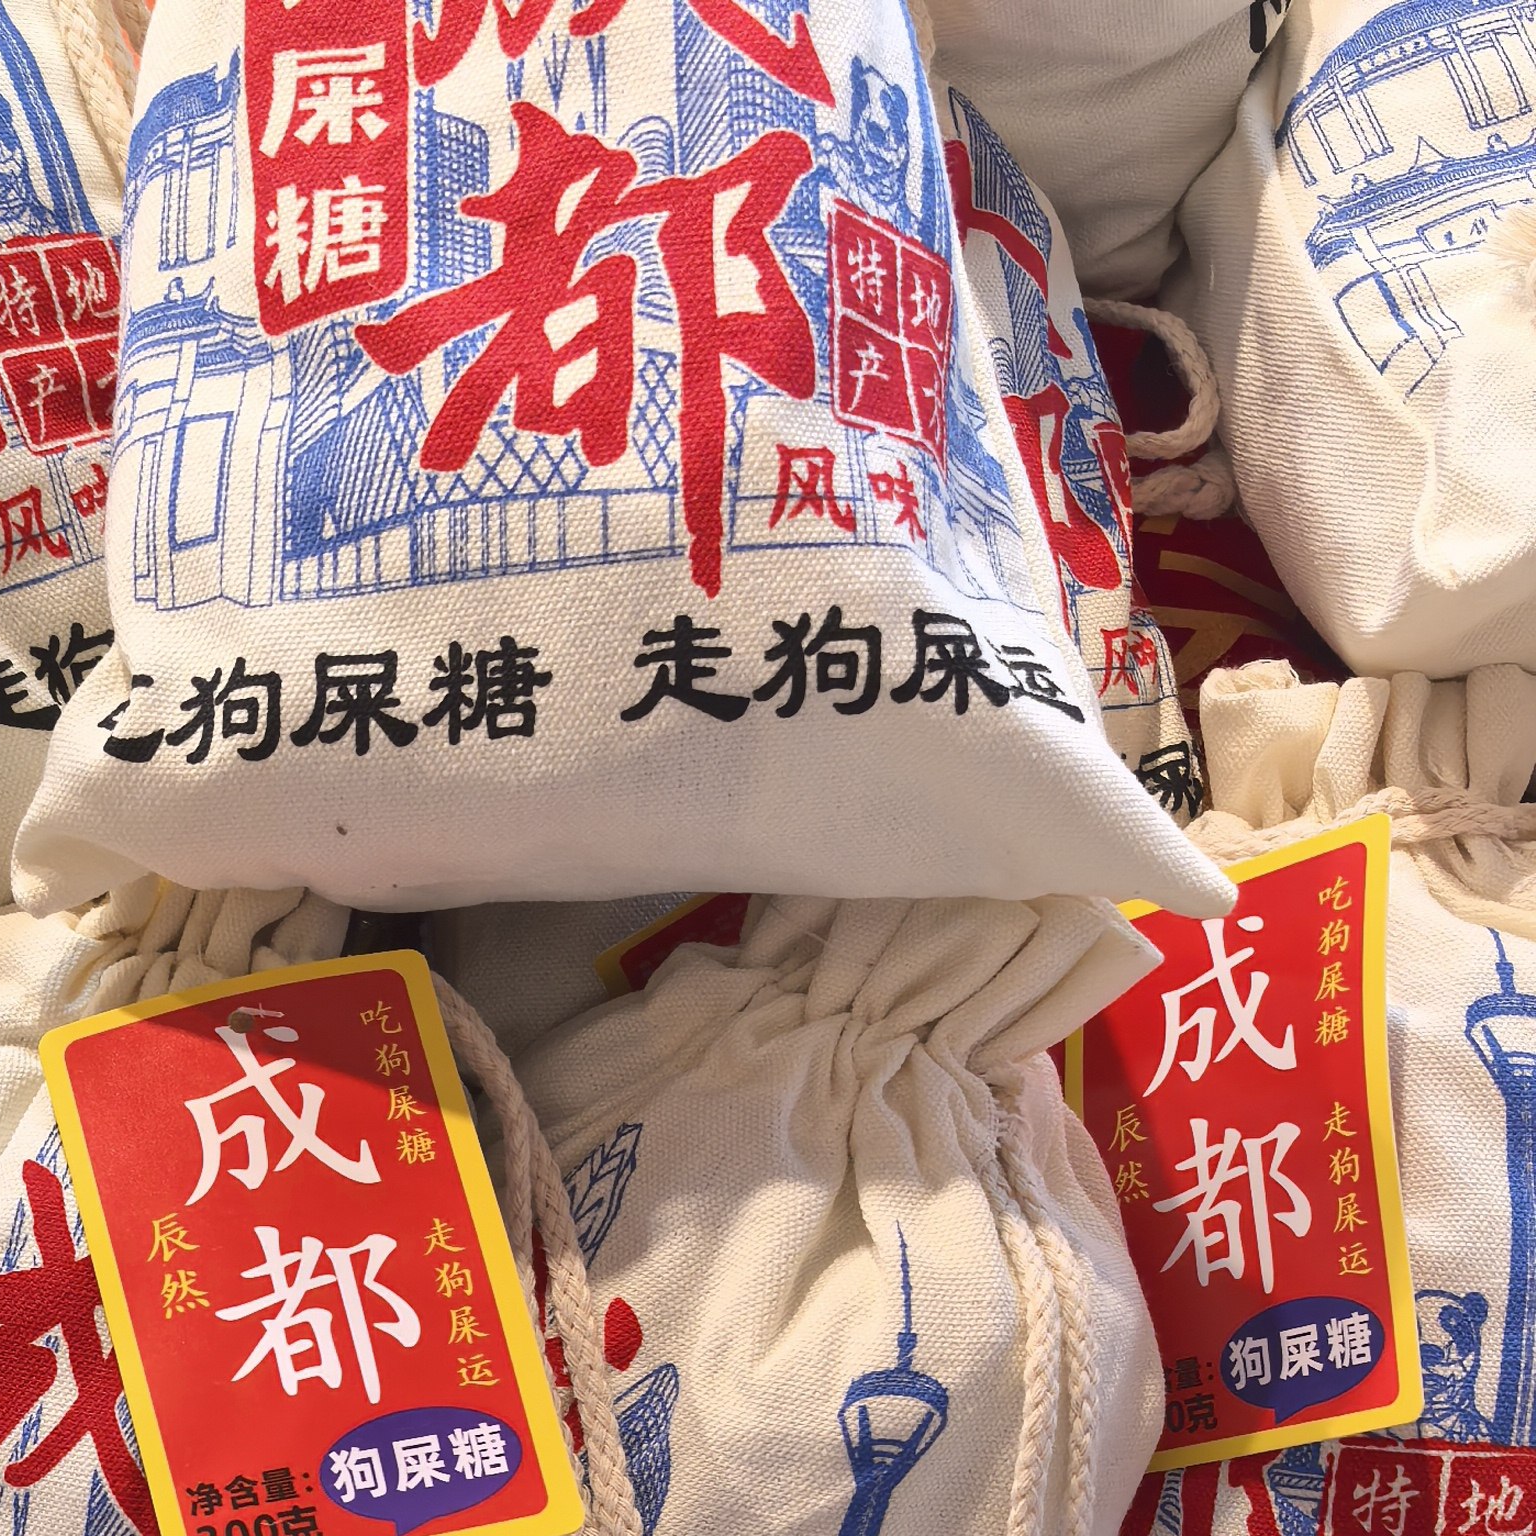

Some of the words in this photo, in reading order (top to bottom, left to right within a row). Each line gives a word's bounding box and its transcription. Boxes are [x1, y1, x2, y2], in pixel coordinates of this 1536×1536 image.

[263, 45, 390, 310] 屎糖
[768, 443, 926, 542] 风味
[621, 605, 1085, 724] 走狗屎运
[1315, 876, 1353, 1047] 吃狗屎糖
[360, 1002, 438, 1167] 吃狗屎糖
[1107, 1102, 1151, 1205] 辰然
[1142, 914, 1314, 1295] 成都
[184, 1004, 422, 1405] 成都
[1321, 1101, 1375, 1277] 走狗屎运
[147, 1213, 212, 1320] 辰然
[423, 1216, 501, 1389] 走狗屎运
[1227, 1311, 1373, 1391] 狗屎糖
[186, 1467, 316, 1520] 净含量：
[329, 1422, 508, 1504] 狗屎糖
